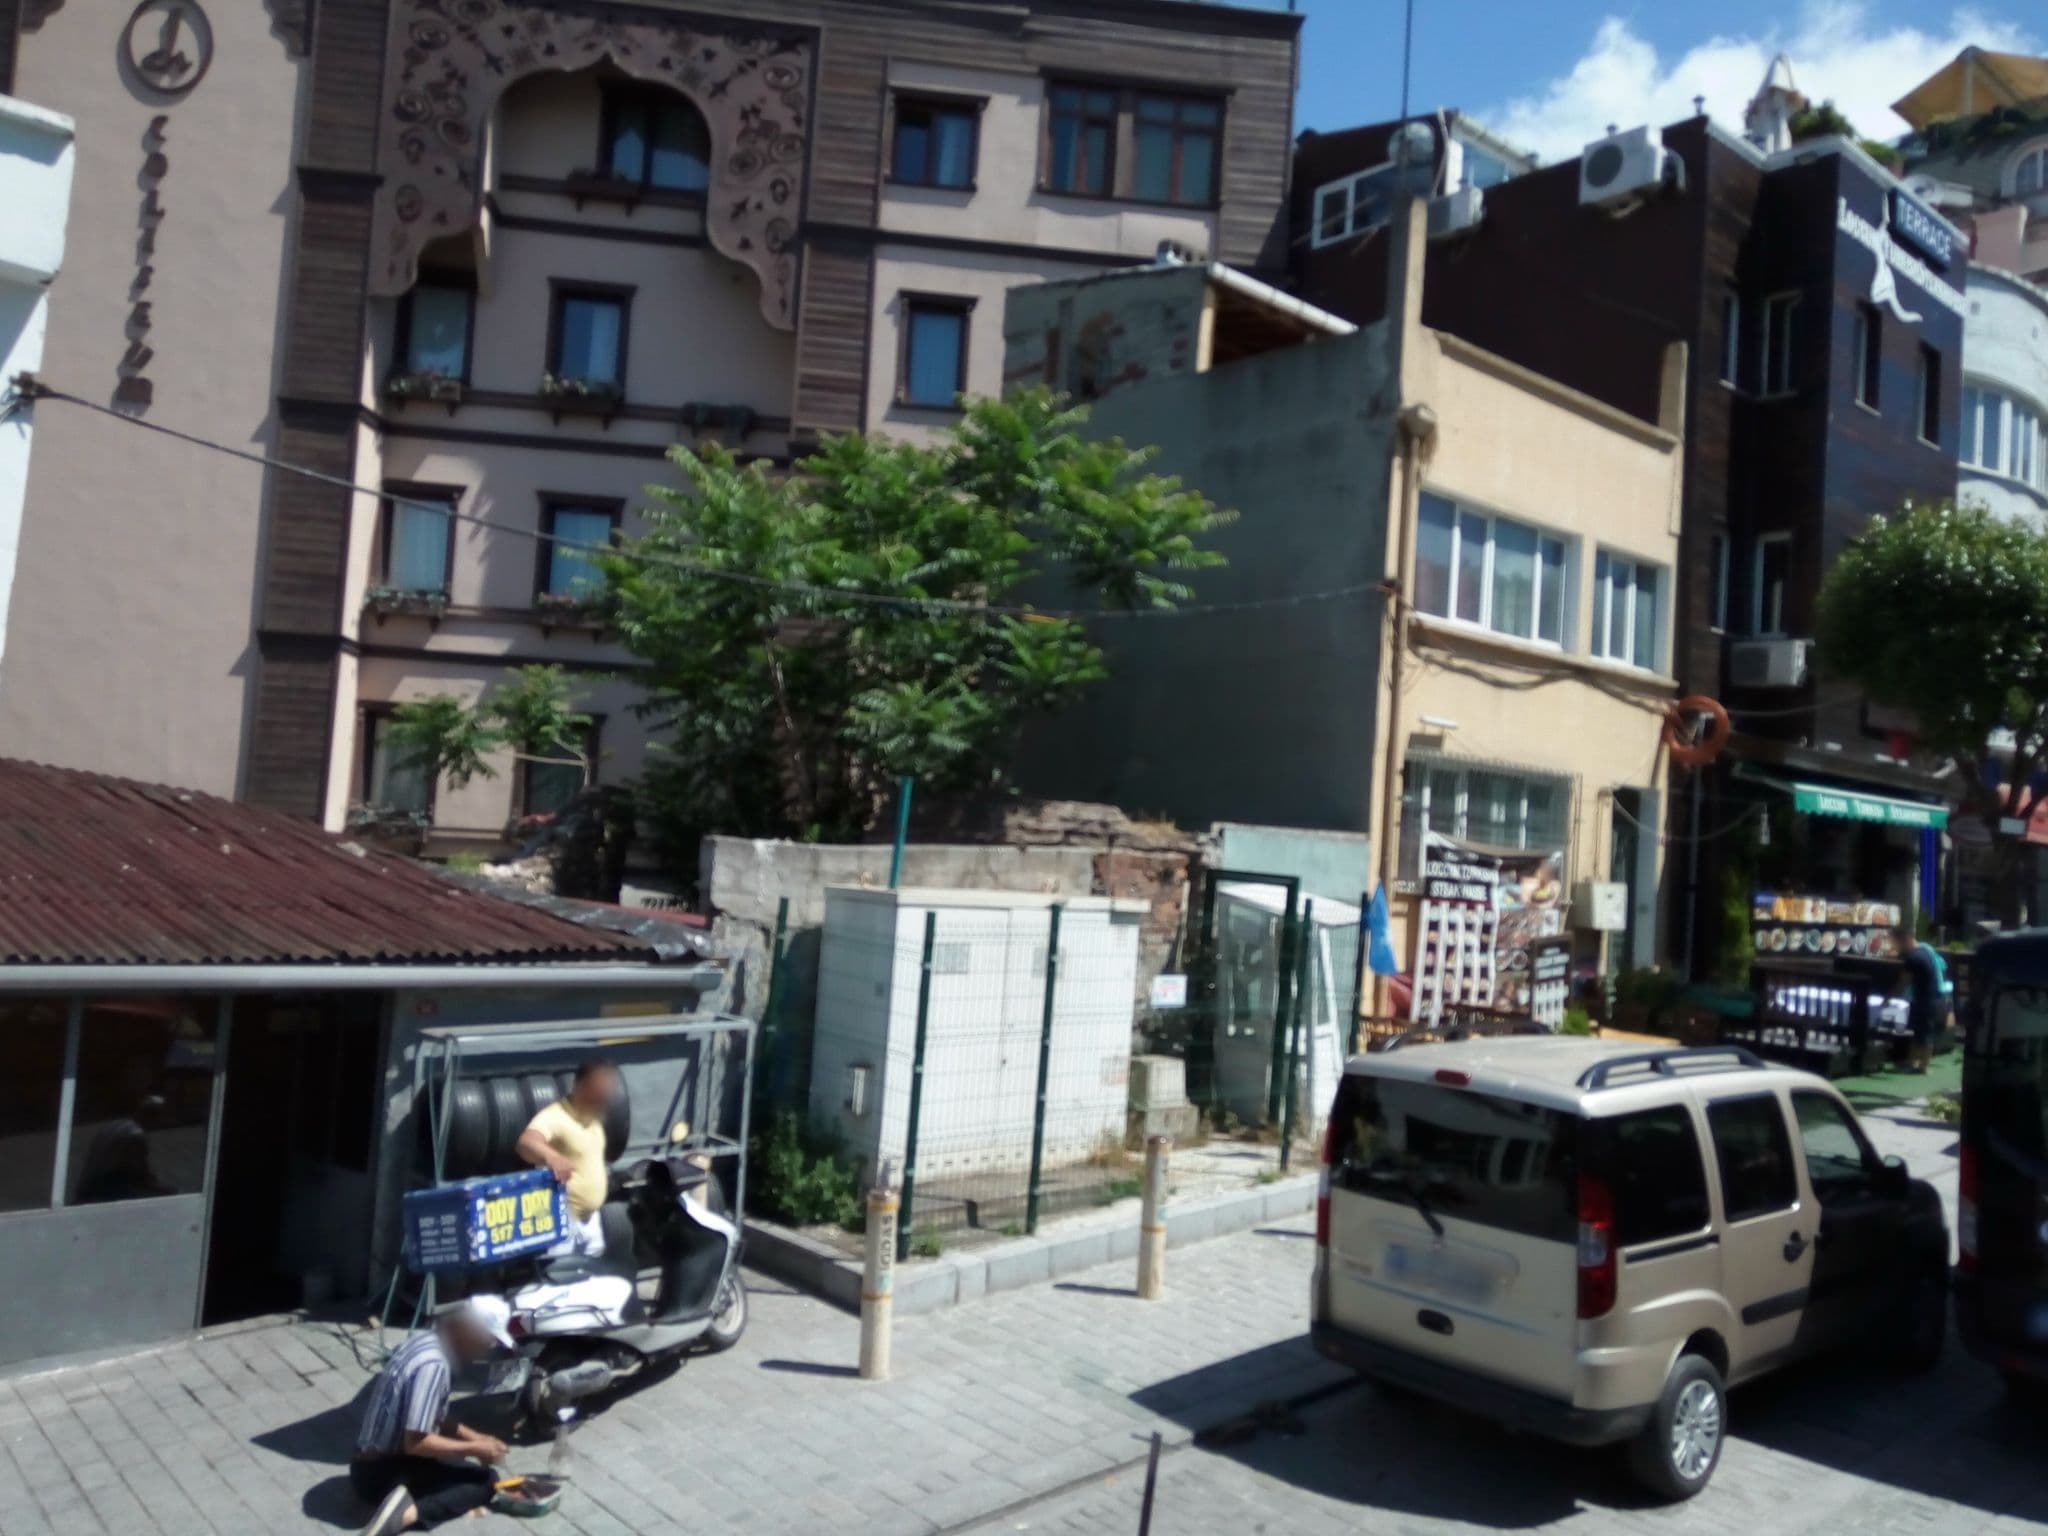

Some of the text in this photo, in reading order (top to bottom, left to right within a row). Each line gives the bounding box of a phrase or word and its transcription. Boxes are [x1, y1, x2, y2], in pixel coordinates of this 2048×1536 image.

[1898, 198, 1952, 261] TERRACE
[485, 1187, 552, 1228] DOY DOY
